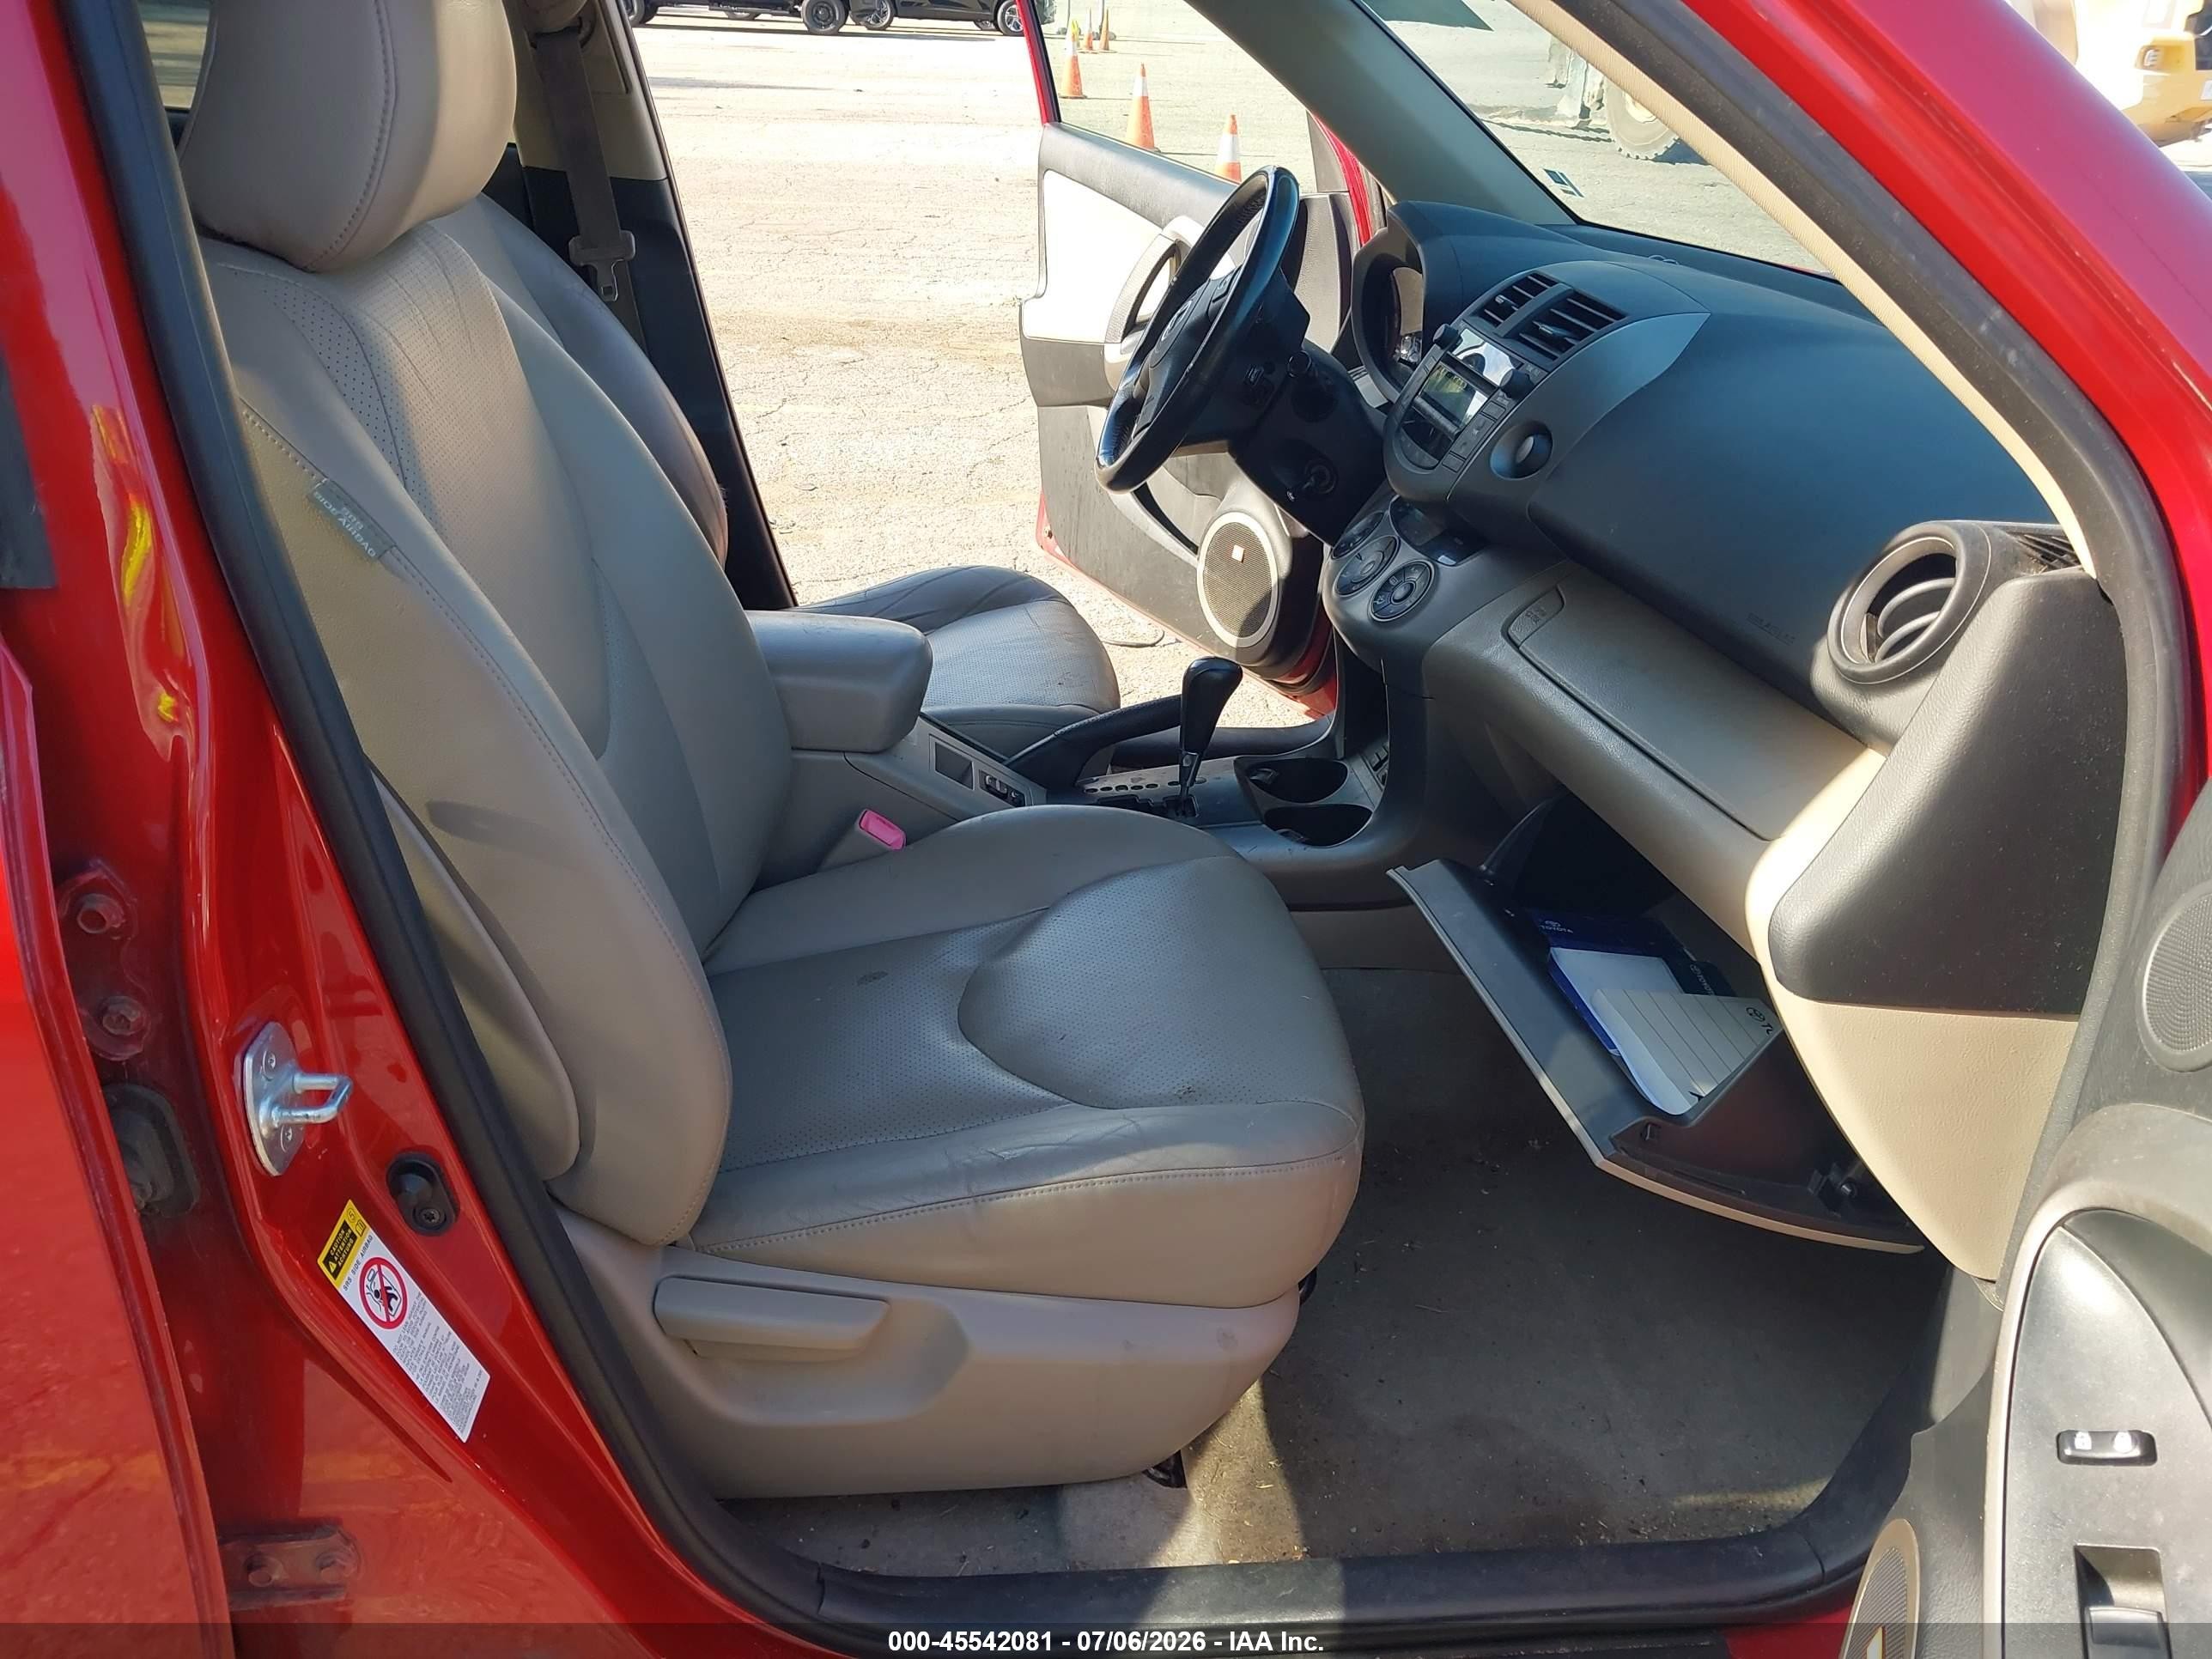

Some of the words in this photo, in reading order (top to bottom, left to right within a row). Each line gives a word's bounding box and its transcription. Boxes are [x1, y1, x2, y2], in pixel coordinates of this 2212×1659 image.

[338, 516, 376, 558] AIRBAG
[330, 1228, 345, 1256] CAUTION
[333, 1228, 352, 1262] ATTENTION
[337, 1237, 355, 1267] ACHTUNG
[343, 1276, 353, 1291] SRS
[351, 1260, 362, 1275] SIDE
[361, 1235, 374, 1258] AIRBAG
